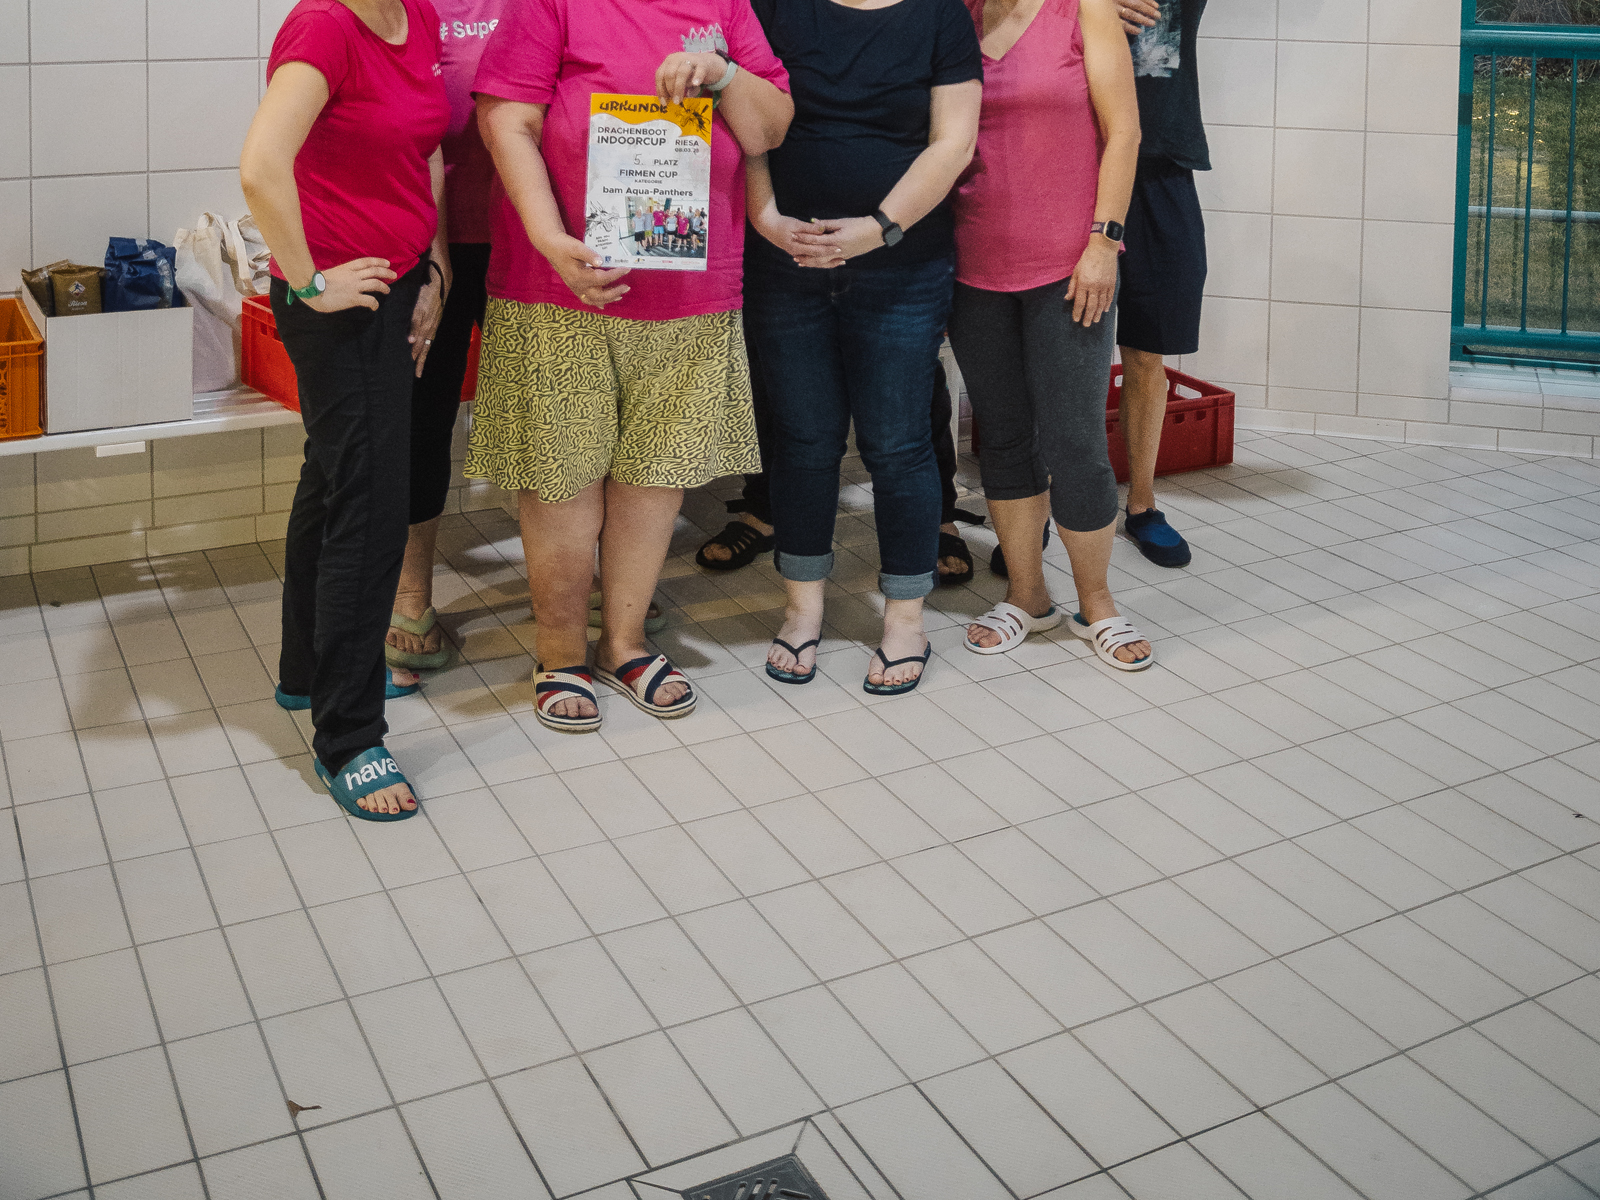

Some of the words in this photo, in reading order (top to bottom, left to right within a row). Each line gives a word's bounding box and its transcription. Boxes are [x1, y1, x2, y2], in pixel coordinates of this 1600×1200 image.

[597, 126, 668, 136] DRACHENBOOT
[597, 135, 667, 146] INDOORCUP
[675, 139, 699, 147] RIESA
[653, 159, 679, 167] PLATZ
[619, 168, 656, 178] FIRMEN
[658, 170, 678, 179] CUP
[602, 186, 623, 194] bam
[625, 187, 693, 197] Aqua-Panthers
